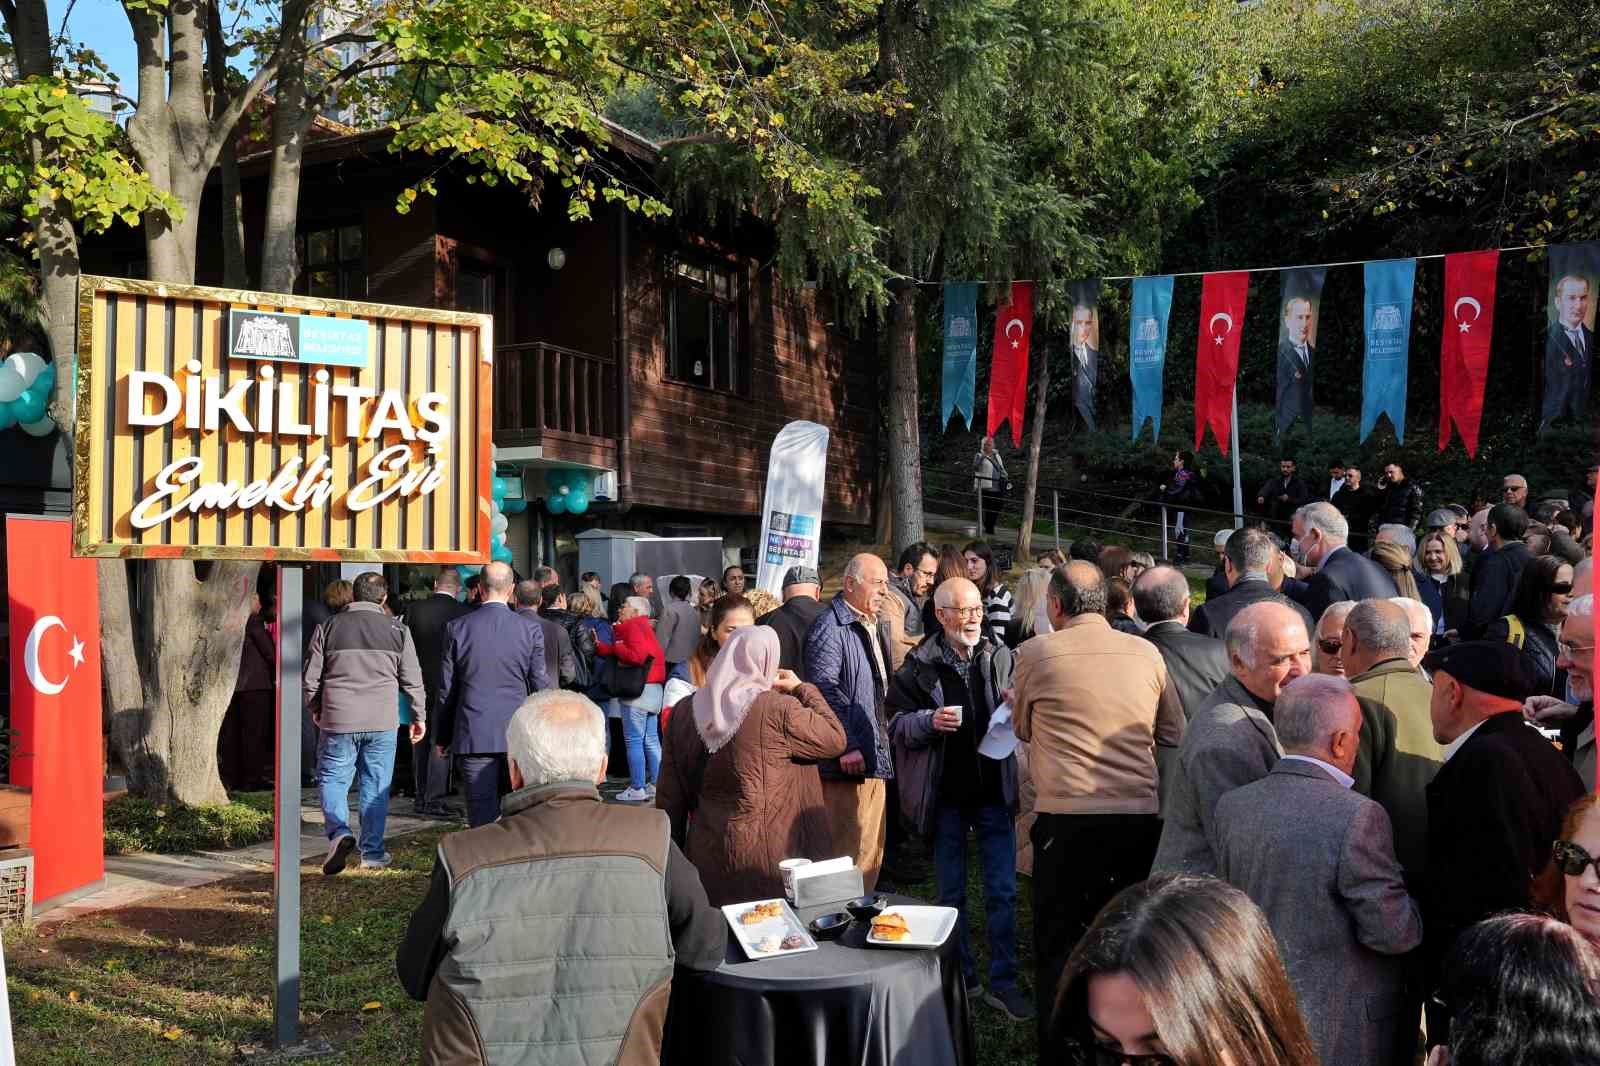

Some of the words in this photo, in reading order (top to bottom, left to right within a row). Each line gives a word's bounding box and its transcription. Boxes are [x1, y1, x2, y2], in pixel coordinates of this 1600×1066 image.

[127, 359, 450, 453] DİKİLİTAŞ
[130, 455, 335, 529] Emekli
[346, 444, 447, 511] Evi
